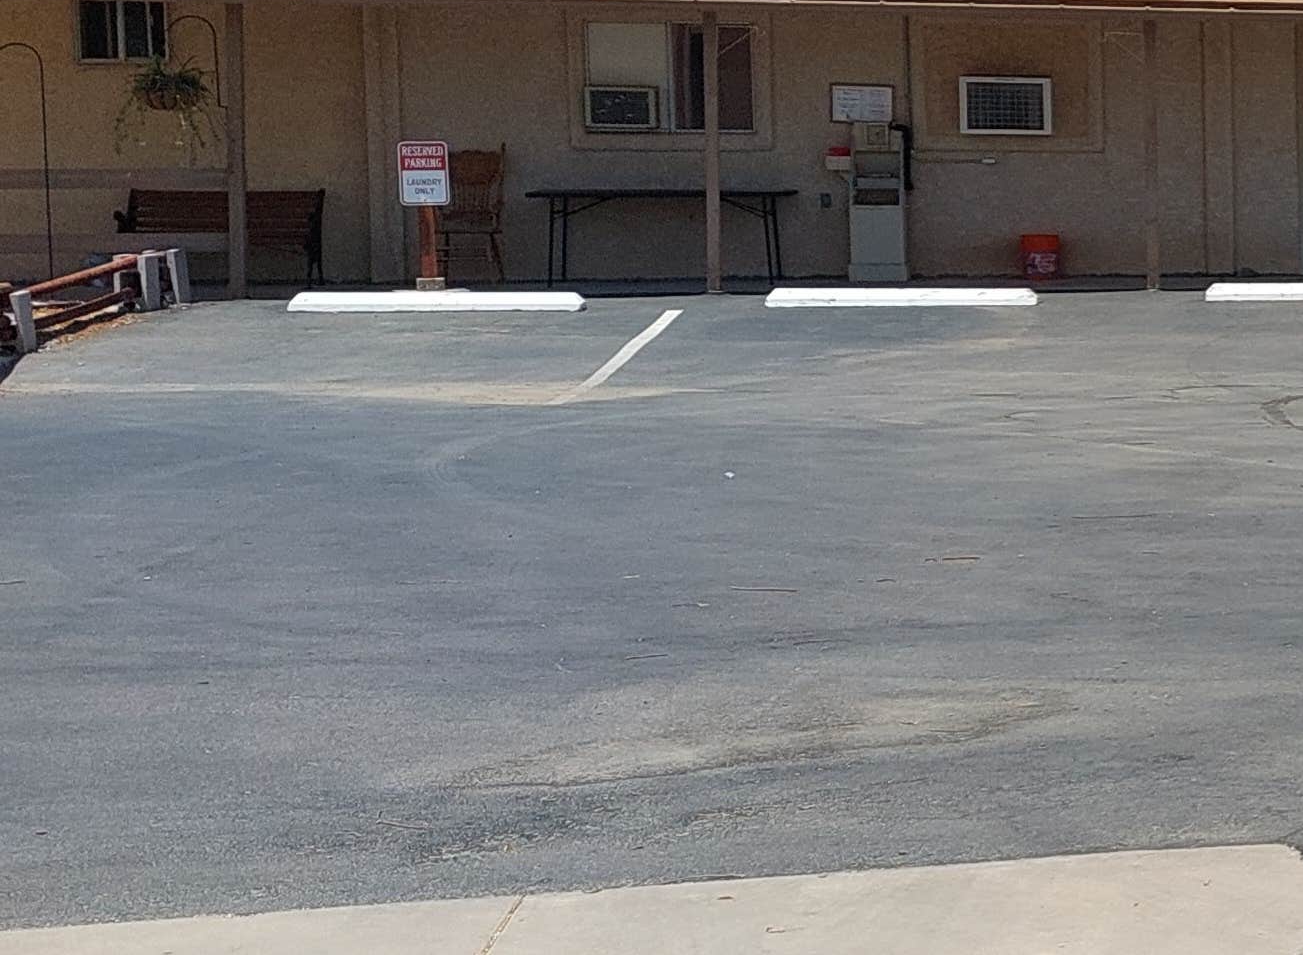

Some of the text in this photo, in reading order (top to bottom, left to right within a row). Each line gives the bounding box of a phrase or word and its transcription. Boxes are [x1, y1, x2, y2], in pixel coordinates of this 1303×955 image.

[401, 146, 443, 156] RESERVED
[404, 157, 442, 168] PARKING
[406, 178, 442, 186] LAUNDRY
[414, 187, 435, 195] ONLY
